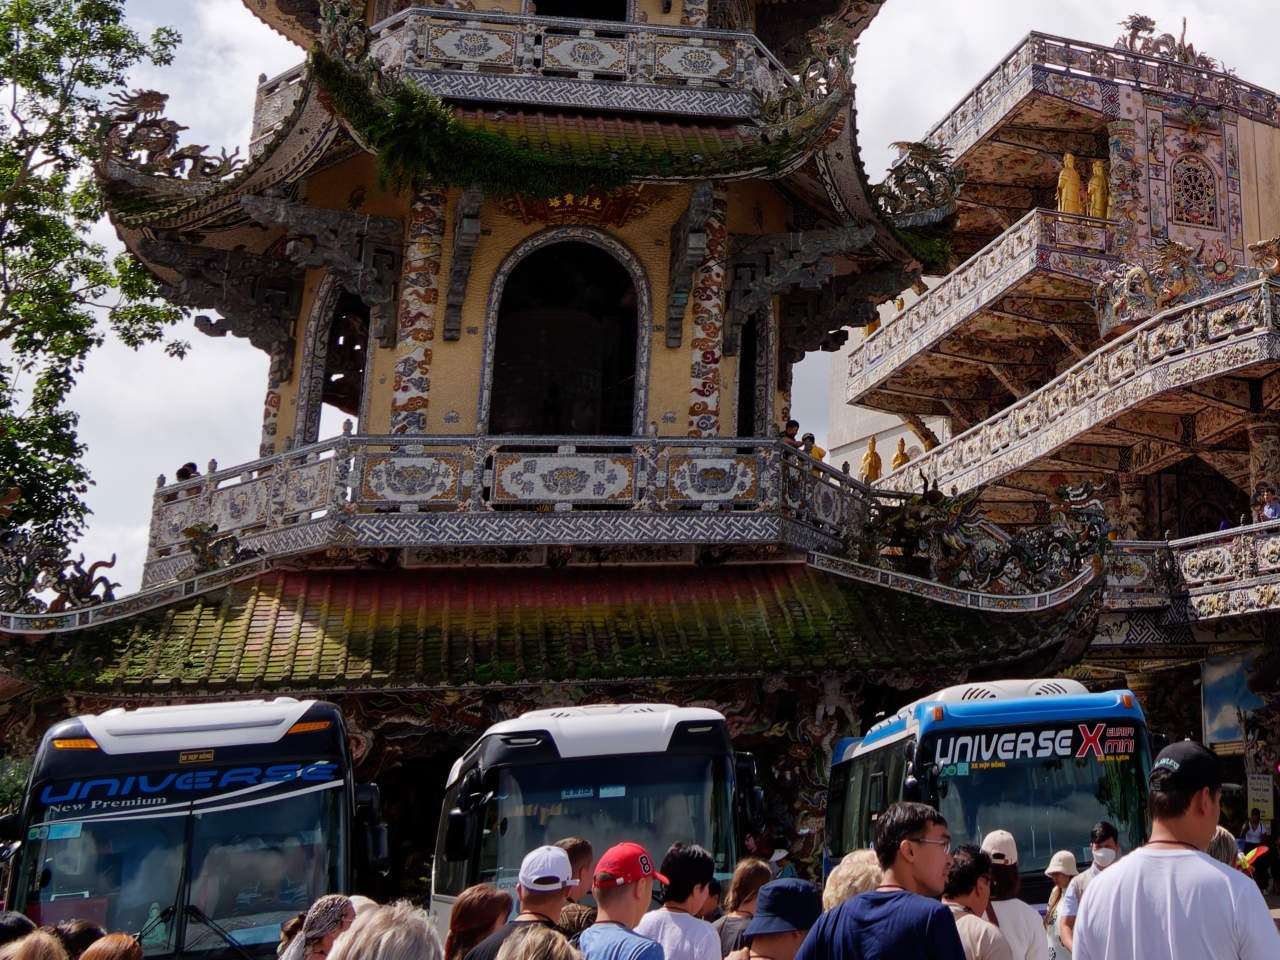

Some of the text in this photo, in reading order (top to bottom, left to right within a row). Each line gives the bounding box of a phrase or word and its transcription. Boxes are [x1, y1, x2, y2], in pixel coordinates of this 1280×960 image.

[934, 723, 1106, 765] UNIVERSE X
[1104, 739, 1135, 754] mini
[40, 763, 338, 804] UNIVERSE
[50, 795, 167, 814] New Premium
[639, 854, 651, 874] 8
